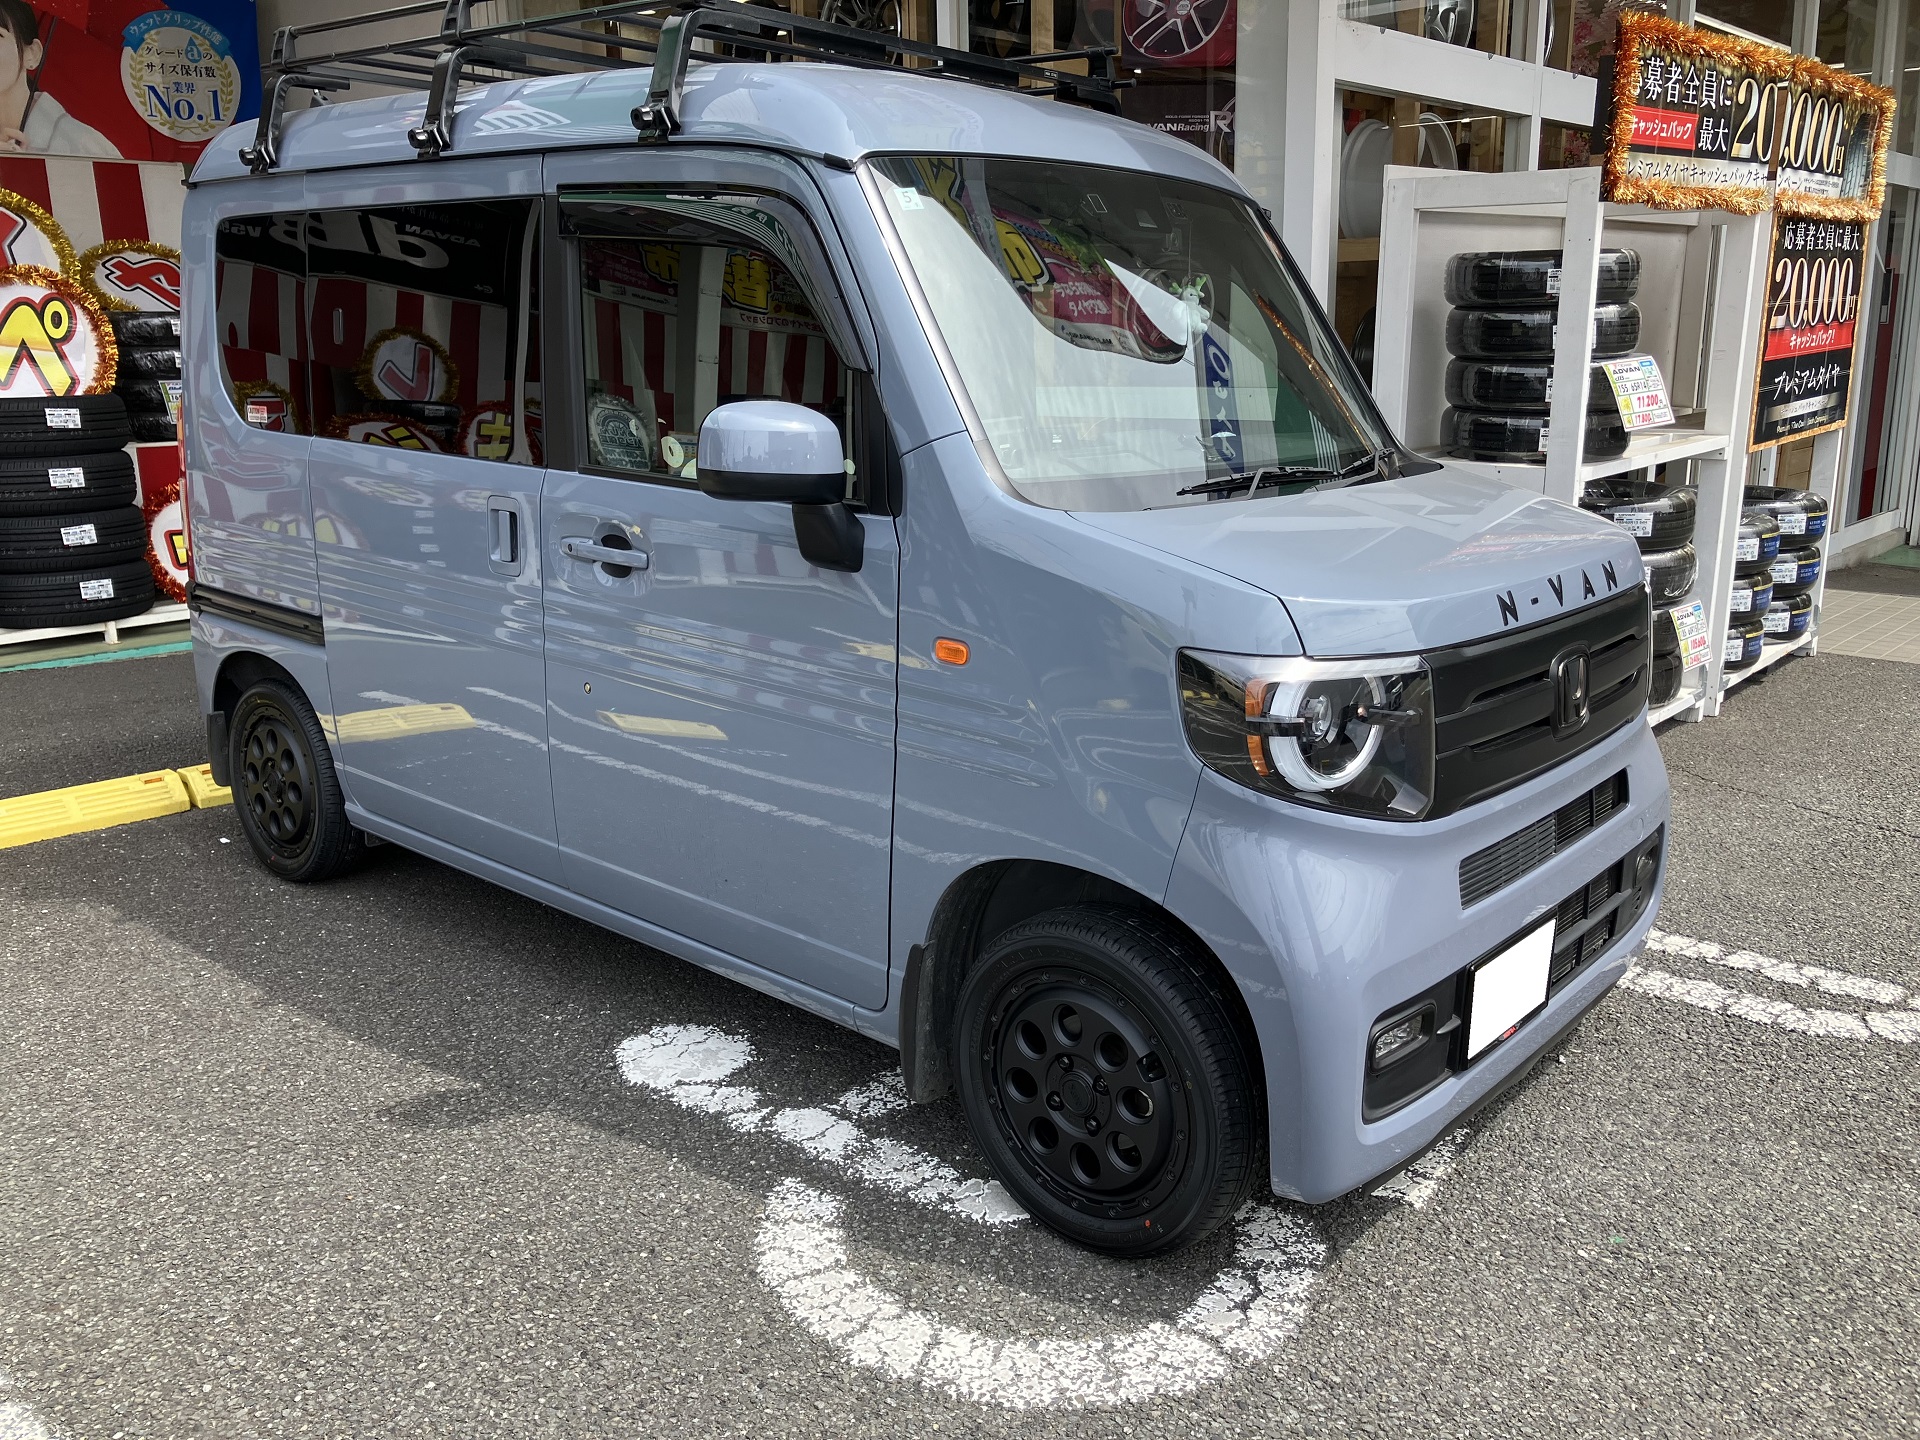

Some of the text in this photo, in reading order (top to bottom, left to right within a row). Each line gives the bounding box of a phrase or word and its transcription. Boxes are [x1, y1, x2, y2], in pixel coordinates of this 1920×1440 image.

[129, 12, 223, 45] ウェットグリップ性能
[144, 61, 217, 79] サイズ保有数
[142, 84, 226, 122] No.1
[171, 81, 197, 95] 業界
[1631, 116, 1693, 140] キャッシュバック
[1698, 116, 1729, 153] 最大
[902, 191, 912, 203] 5
[1783, 221, 1860, 251] 応募者全員に最大
[1770, 257, 1857, 330] 20,000円
[1789, 329, 1836, 351] キャッシュバック!
[1612, 366, 1641, 375] ADVAN
[1773, 363, 1841, 401] プレミアムタイヤ
[1496, 560, 1618, 627] N-VAN
